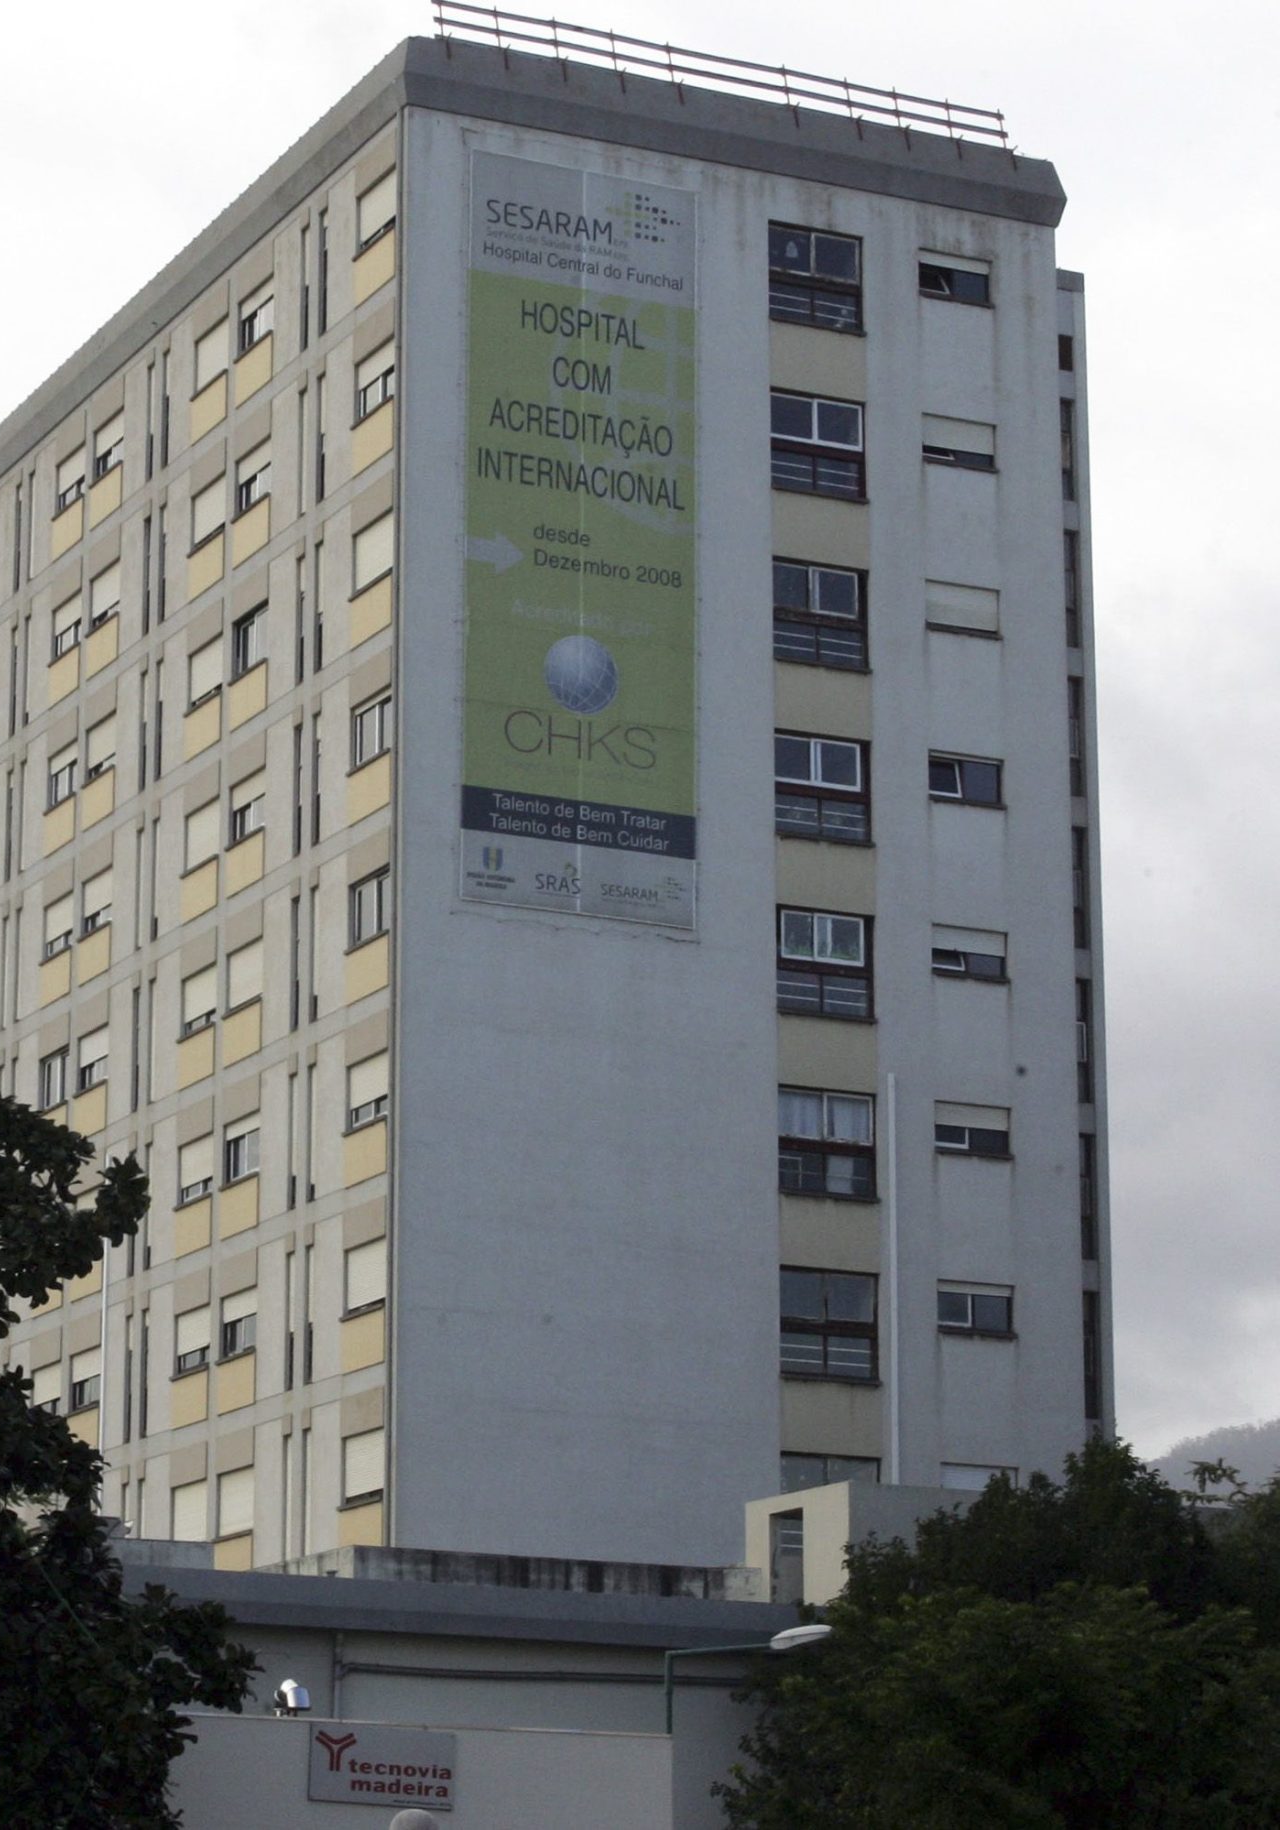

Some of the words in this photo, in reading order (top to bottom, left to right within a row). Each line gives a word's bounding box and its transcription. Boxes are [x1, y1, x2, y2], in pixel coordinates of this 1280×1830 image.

[486, 199, 613, 245] SESARAM
[483, 240, 542, 265] Hospital
[547, 252, 599, 276] Central
[603, 264, 622, 280] do
[626, 267, 684, 292] Funchal
[521, 299, 645, 350] HOSPITAL
[552, 356, 612, 395] COM
[489, 397, 673, 458] ACREDITAÇÃO
[477, 448, 685, 511] INTERNACIONAL
[533, 523, 591, 547] desde
[533, 549, 630, 580] Dezembro
[635, 565, 682, 588] 2008
[504, 709, 657, 770] CHKS
[492, 793, 551, 816] Talento
[554, 803, 575, 818] de
[579, 805, 616, 825] Bem
[621, 810, 668, 831] Tratar
[489, 813, 547, 835] Talento
[551, 823, 572, 838] de
[576, 824, 613, 844] Bem
[617, 830, 669, 851] Cuidar
[535, 872, 582, 896] SRAS
[600, 883, 659, 904] SESARAM
[348, 1758, 452, 1780] tecnovia
[350, 1779, 449, 1798] madeira
